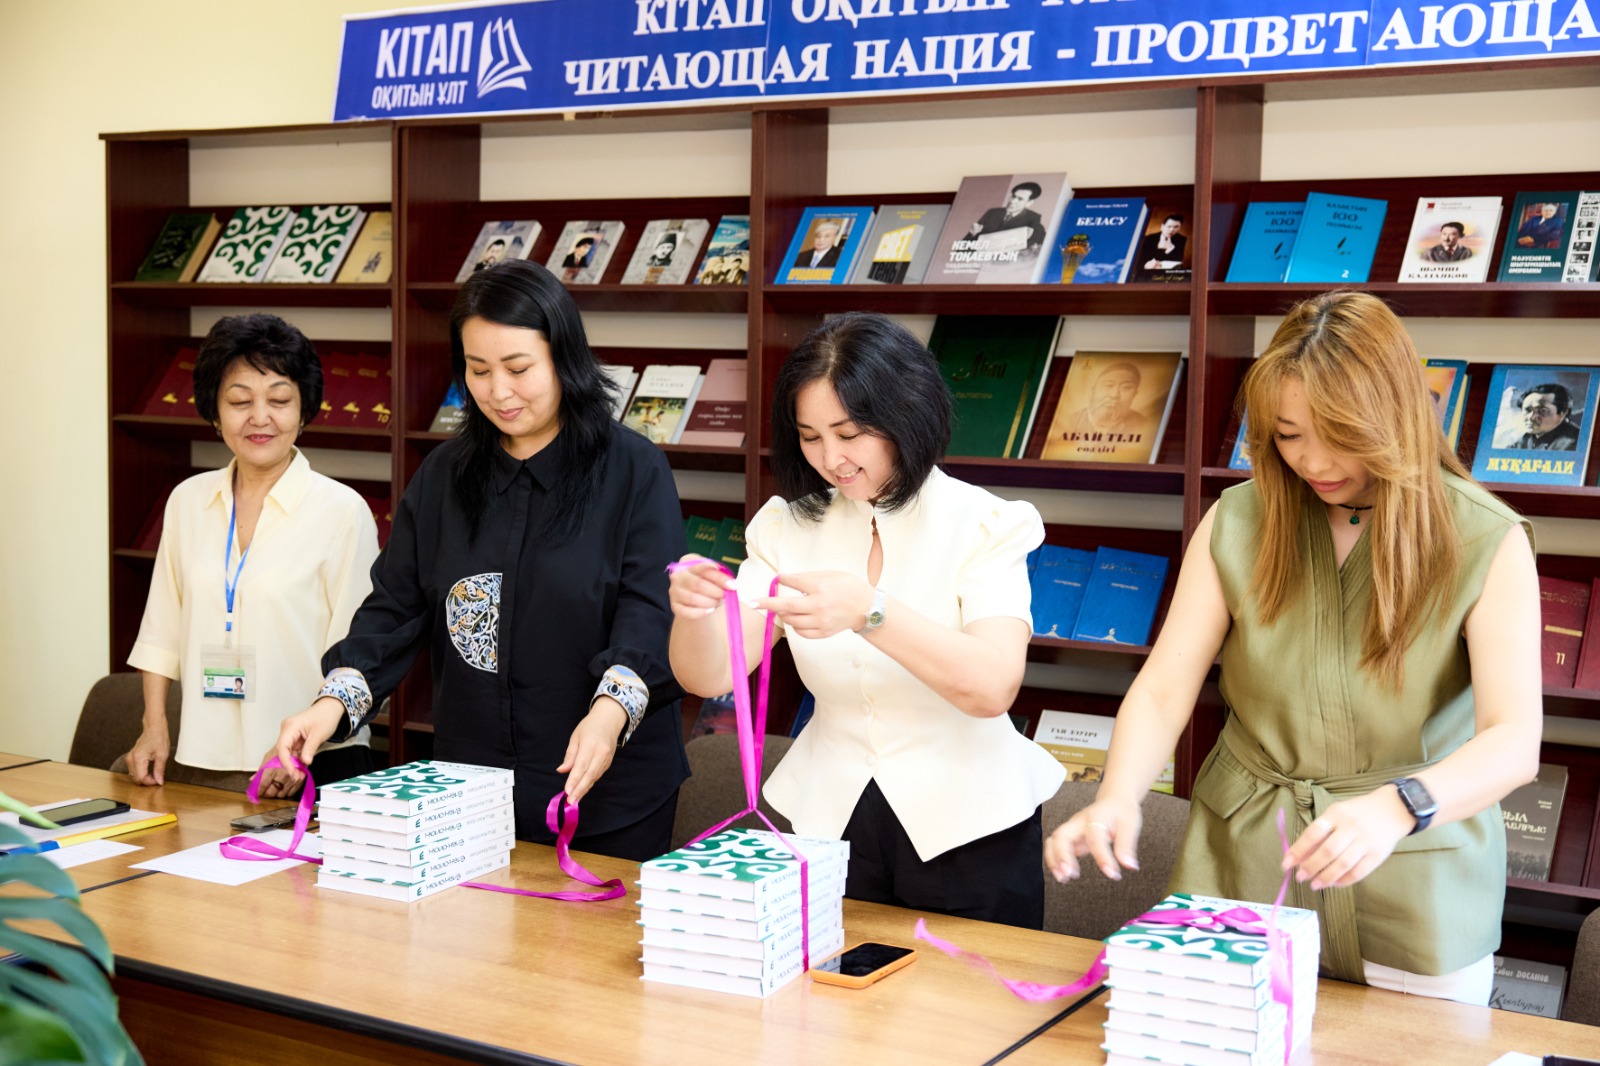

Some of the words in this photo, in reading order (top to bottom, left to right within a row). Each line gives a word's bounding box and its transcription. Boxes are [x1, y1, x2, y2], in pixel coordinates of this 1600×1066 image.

[633, 0, 766, 36] КІТАП
[375, 21, 474, 79] КІТАП
[563, 42, 833, 96] ЧИТАЮЩАЯ
[850, 30, 1036, 84] НАЦИЯ
[371, 84, 435, 111] ОҚИТЫН
[436, 80, 469, 105] ҰЛТ
[1076, 216, 1128, 226] БЕЛАСУ
[951, 240, 990, 250] КЕМЕЛ
[1341, 269, 1349, 278] 2
[1060, 432, 1103, 442] АБАЙ
[1556, 652, 1565, 665] 11
[1516, 970, 1549, 982] ДОСАНОВ
